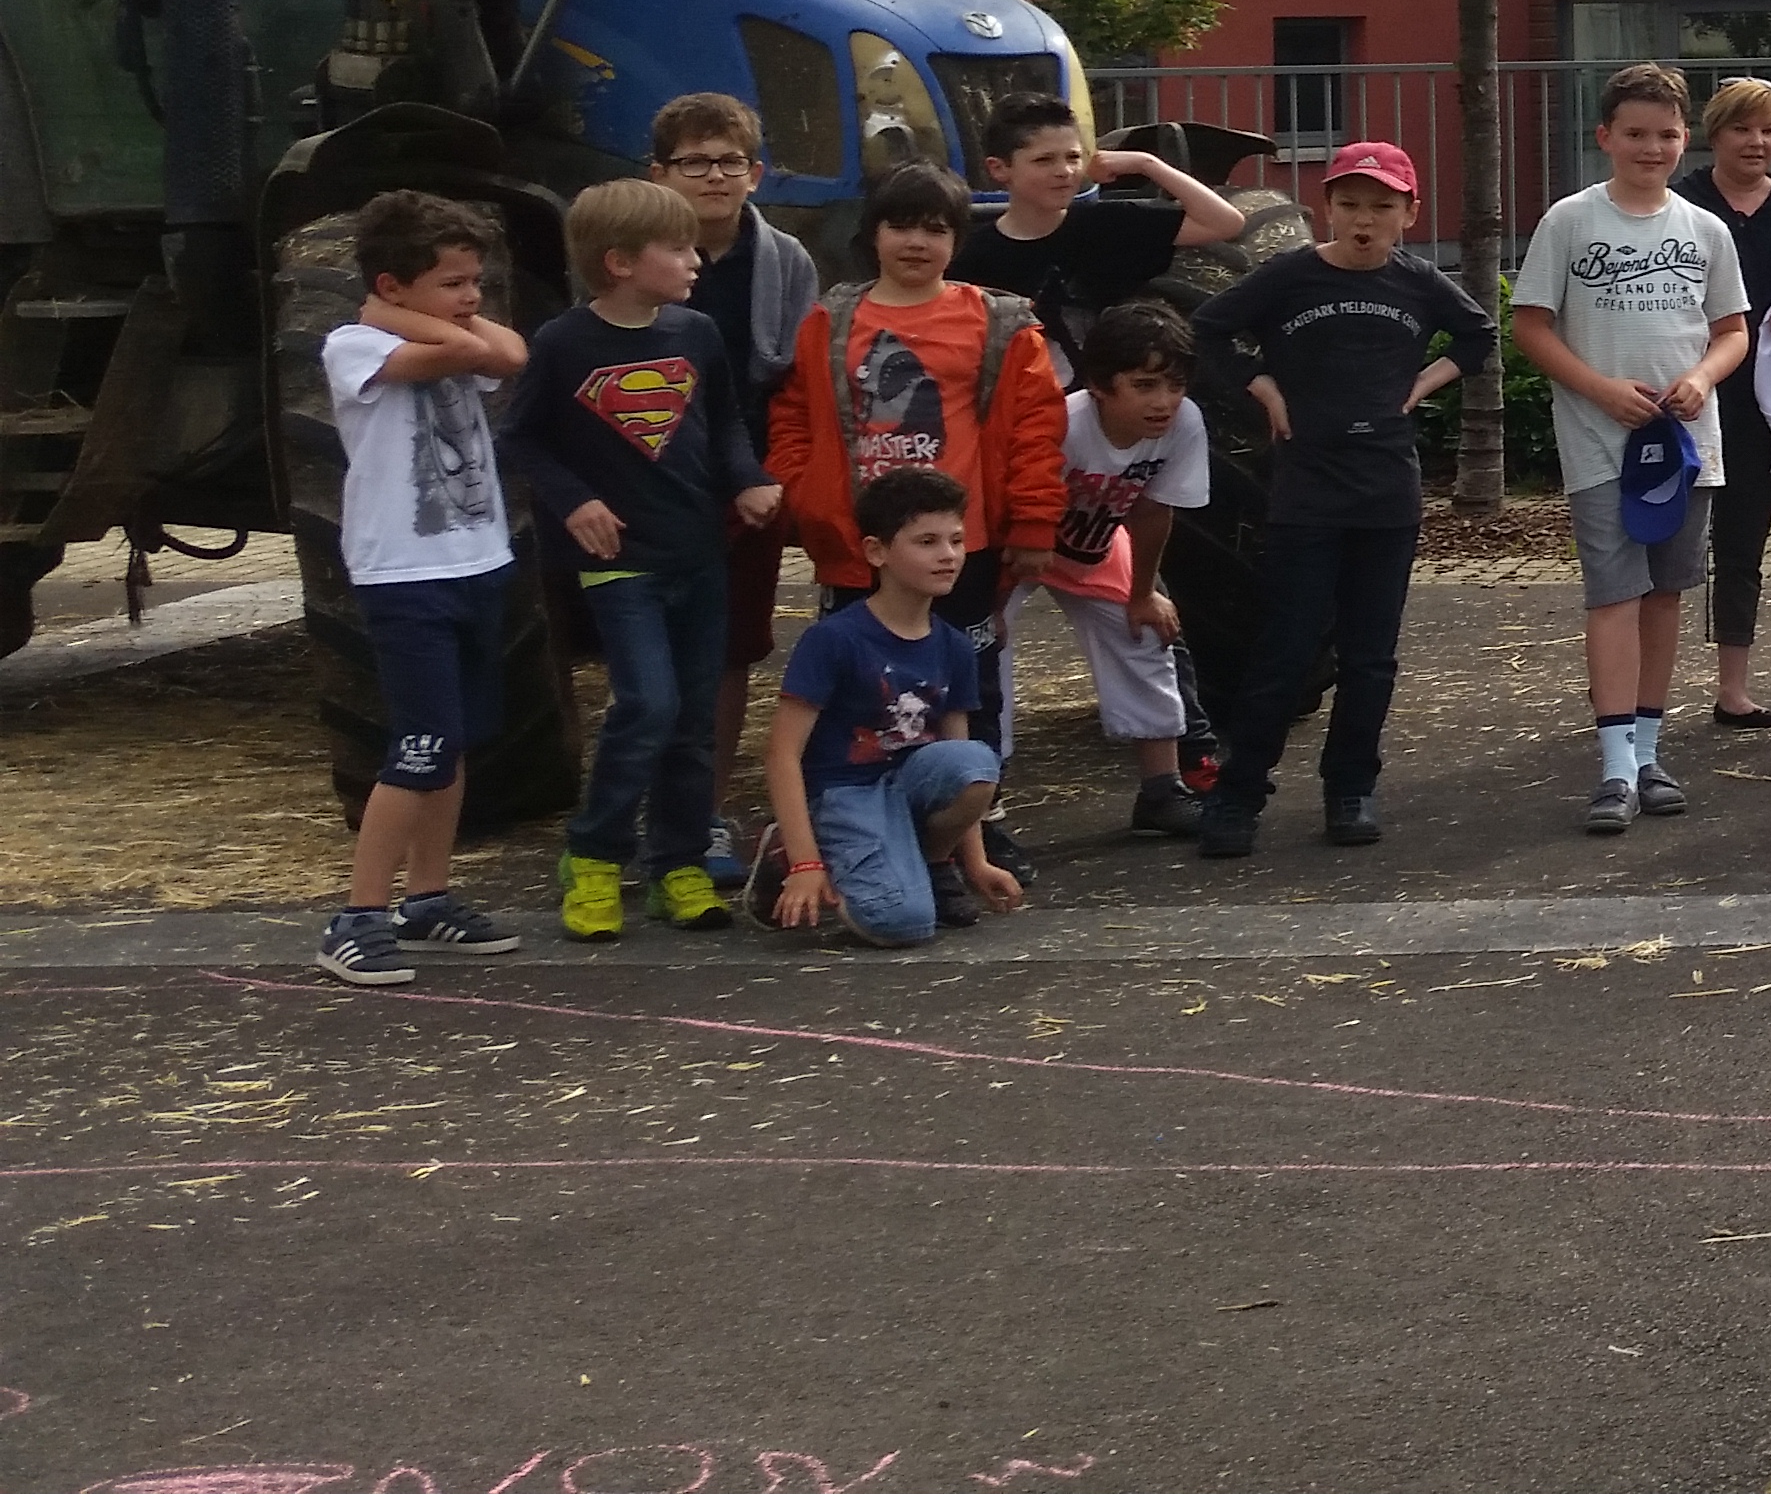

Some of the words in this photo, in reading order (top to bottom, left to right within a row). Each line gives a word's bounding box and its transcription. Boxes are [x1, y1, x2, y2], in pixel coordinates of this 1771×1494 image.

[1571, 242, 1653, 287] Beyond
[1615, 282, 1655, 294] LAND
[1663, 282, 1678, 294] OF
[1595, 297, 1633, 311] GREAT
[1281, 303, 1336, 335] SKATEPARK
[1340, 301, 1401, 321] MELBOURNE
